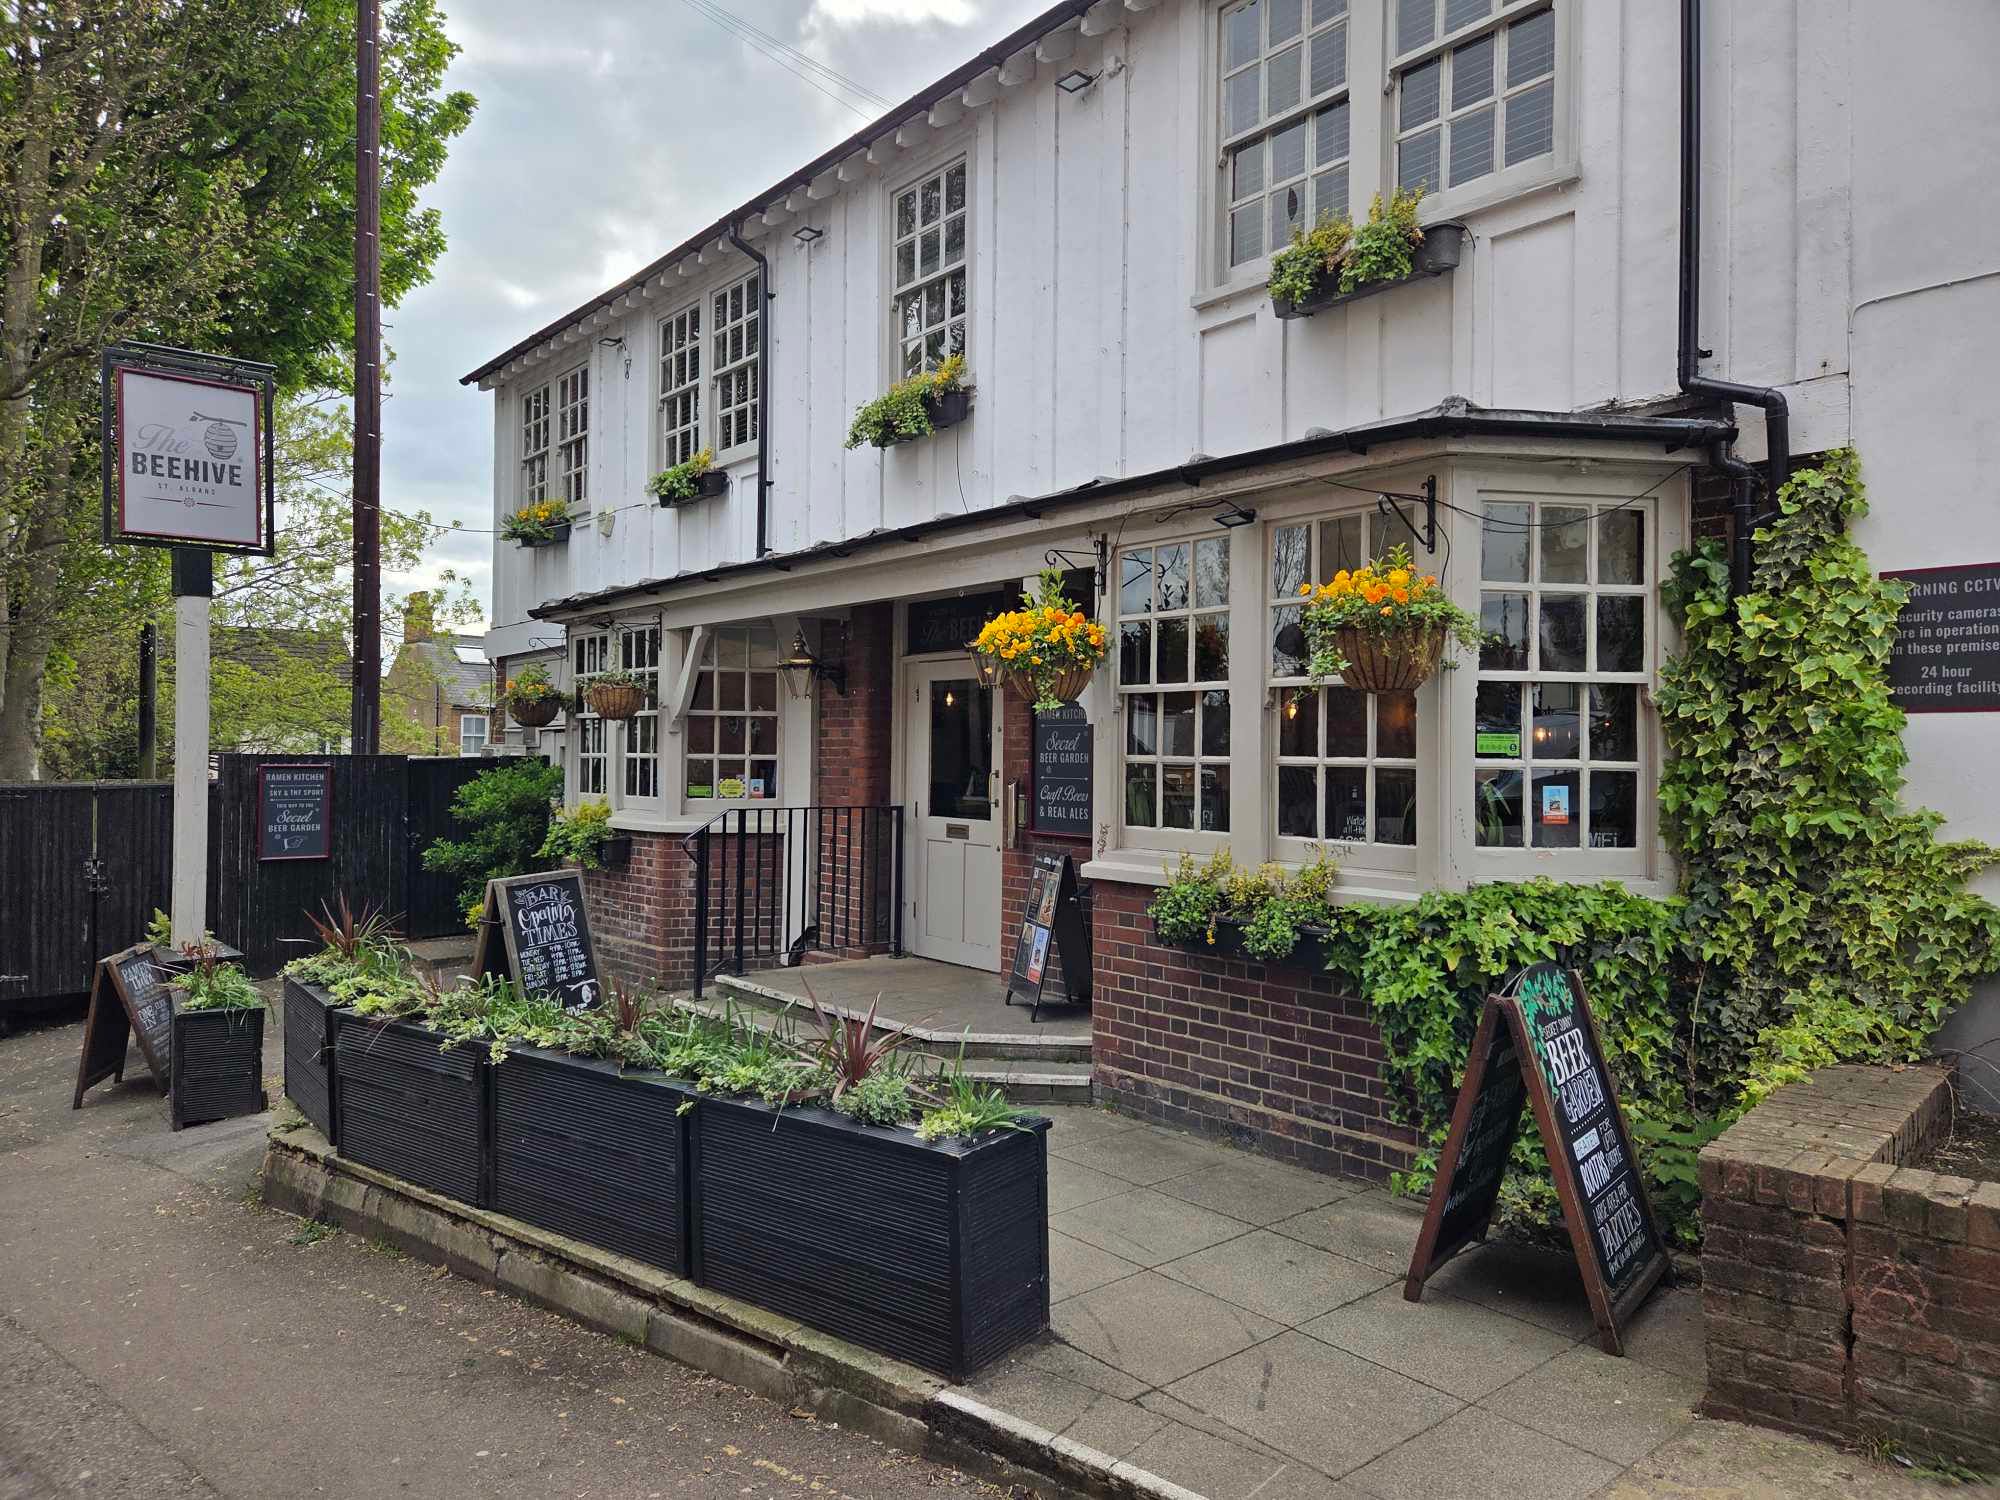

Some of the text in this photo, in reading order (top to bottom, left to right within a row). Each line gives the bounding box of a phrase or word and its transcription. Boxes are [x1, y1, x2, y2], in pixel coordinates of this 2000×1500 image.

[132, 423, 190, 454] The
[131, 451, 242, 487] BEEHIVE
[180, 485, 216, 495] ALBANS
[1908, 581, 1958, 597] RNING
[1899, 609, 1943, 623] ecurity
[1920, 626, 1932, 638] in
[1936, 622, 1999, 639] operation
[1908, 642, 1942, 655] these
[1947, 639, 2000, 656] premise
[1921, 665, 1972, 679] 24 hour
[1046, 730, 1081, 751] Secret
[1039, 752, 1089, 764] BEER GARDEN
[266, 773, 325, 781] RAMEN KITCHEN
[1040, 784, 1063, 805] Craft
[276, 809, 314, 824] Secret
[1039, 805, 1089, 820] & REAL ALES
[268, 823, 321, 833] BEER GARDEN
[526, 886, 559, 907] BAR
[518, 902, 578, 931] Opening
[522, 920, 578, 947] TIMES
[1546, 1027, 1591, 1086] BEER
[1560, 1066, 1604, 1123] GARDEN
[1598, 1116, 1612, 1135] FOR
[1580, 1150, 1610, 1198] BOOTHS
[1599, 1196, 1642, 1261] PARTIES
